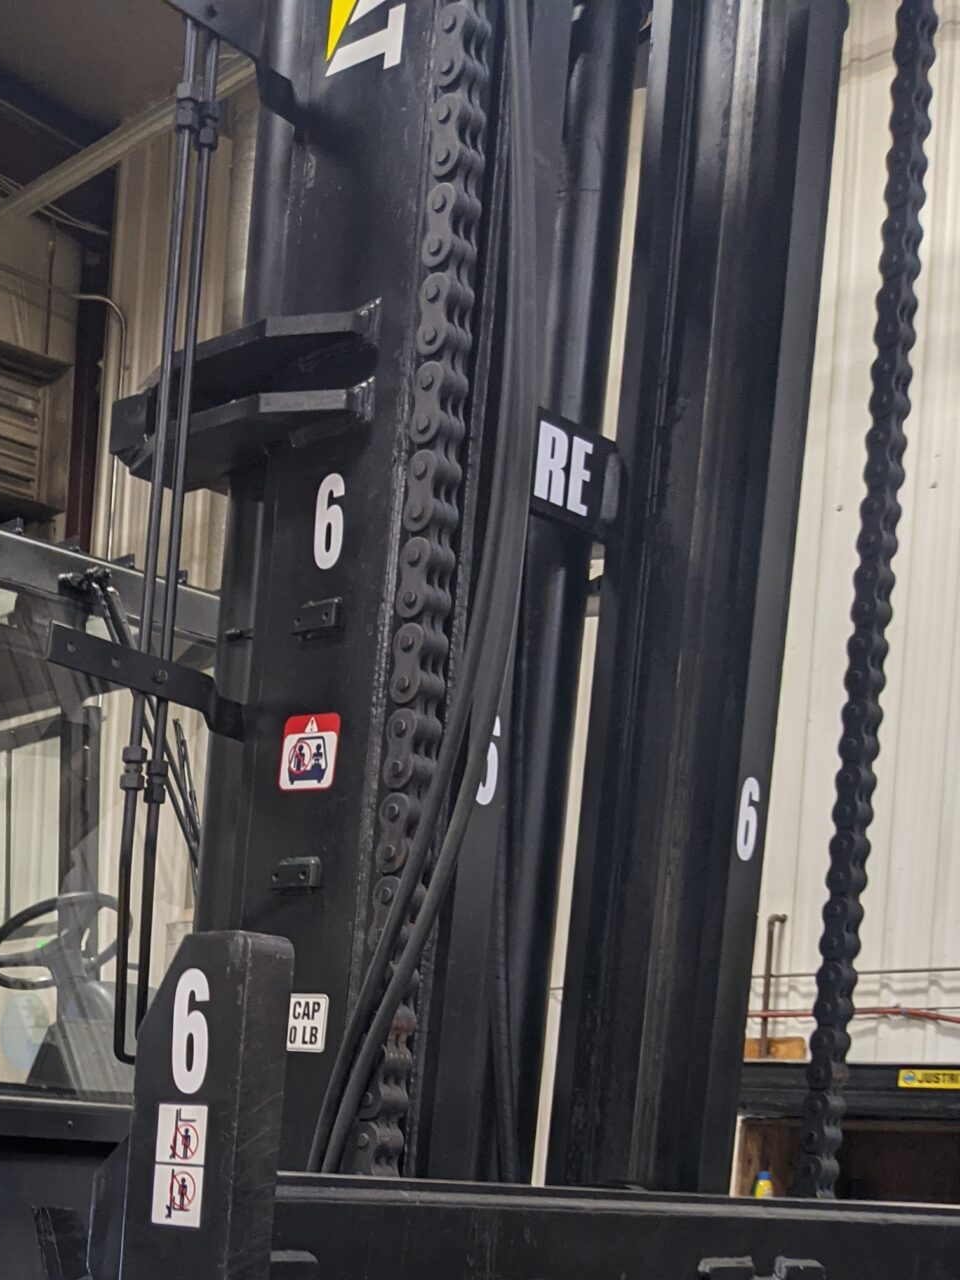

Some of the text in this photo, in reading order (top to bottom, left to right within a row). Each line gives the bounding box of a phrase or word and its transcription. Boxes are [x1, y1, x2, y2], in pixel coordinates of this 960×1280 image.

[534, 421, 593, 517] RE
[313, 472, 345, 569] 6
[737, 776, 760, 861] 6
[172, 968, 210, 1094] 6
[292, 1001, 321, 1020] CAP
[301, 1026, 319, 1045] LB
